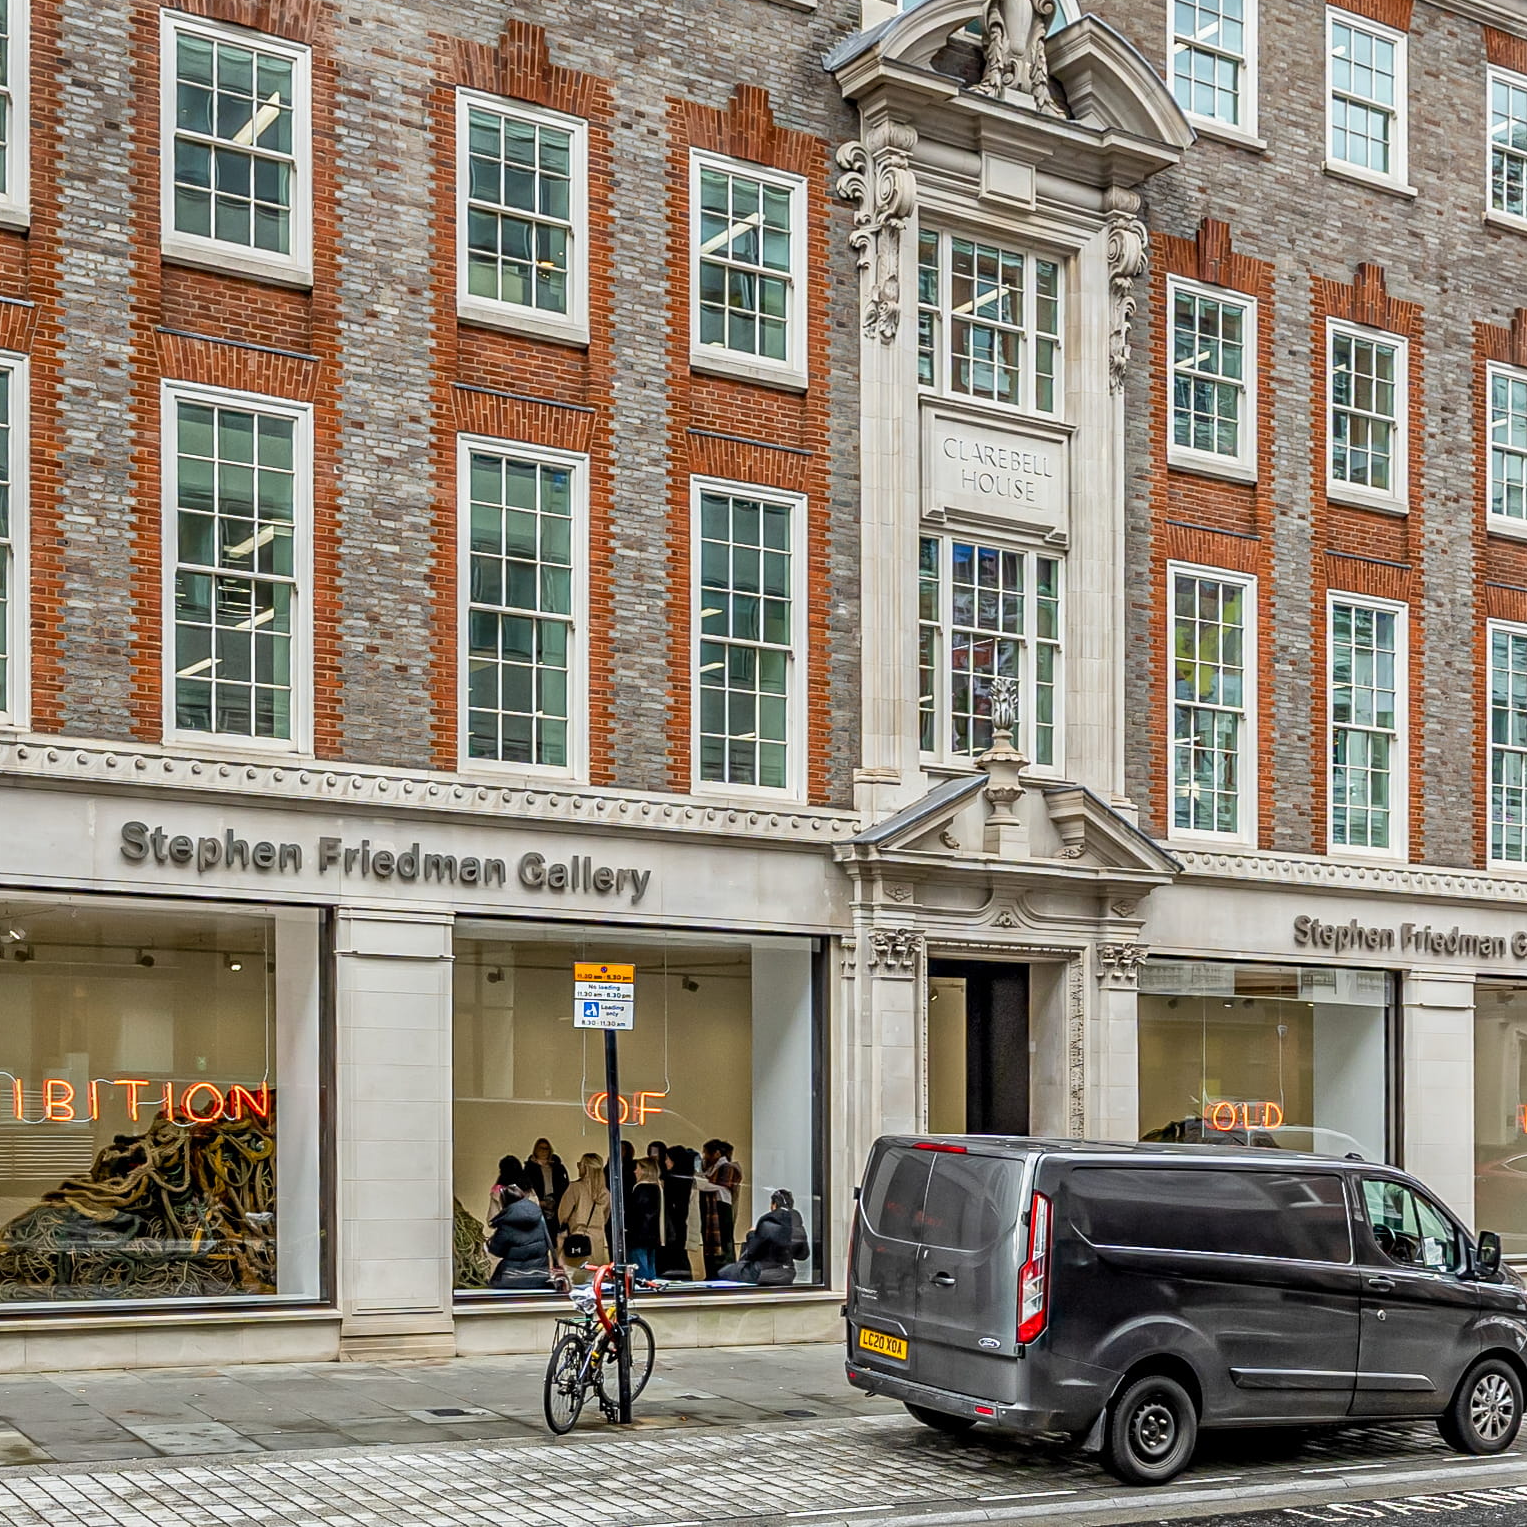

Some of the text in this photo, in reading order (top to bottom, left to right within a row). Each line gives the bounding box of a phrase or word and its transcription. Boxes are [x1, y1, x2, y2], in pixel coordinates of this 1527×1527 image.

[943, 437, 1053, 478] CLAREBELL
[961, 469, 1035, 502] HOUSE
[119, 820, 652, 904] Stephen Friedman Gallery
[1293, 914, 1395, 954] Stephen
[1400, 923, 1506, 958] Friedman
[593, 1090, 666, 1126] OF
[1212, 1100, 1284, 1131] OLD
[862, 1329, 903, 1355] LC20 XOA
